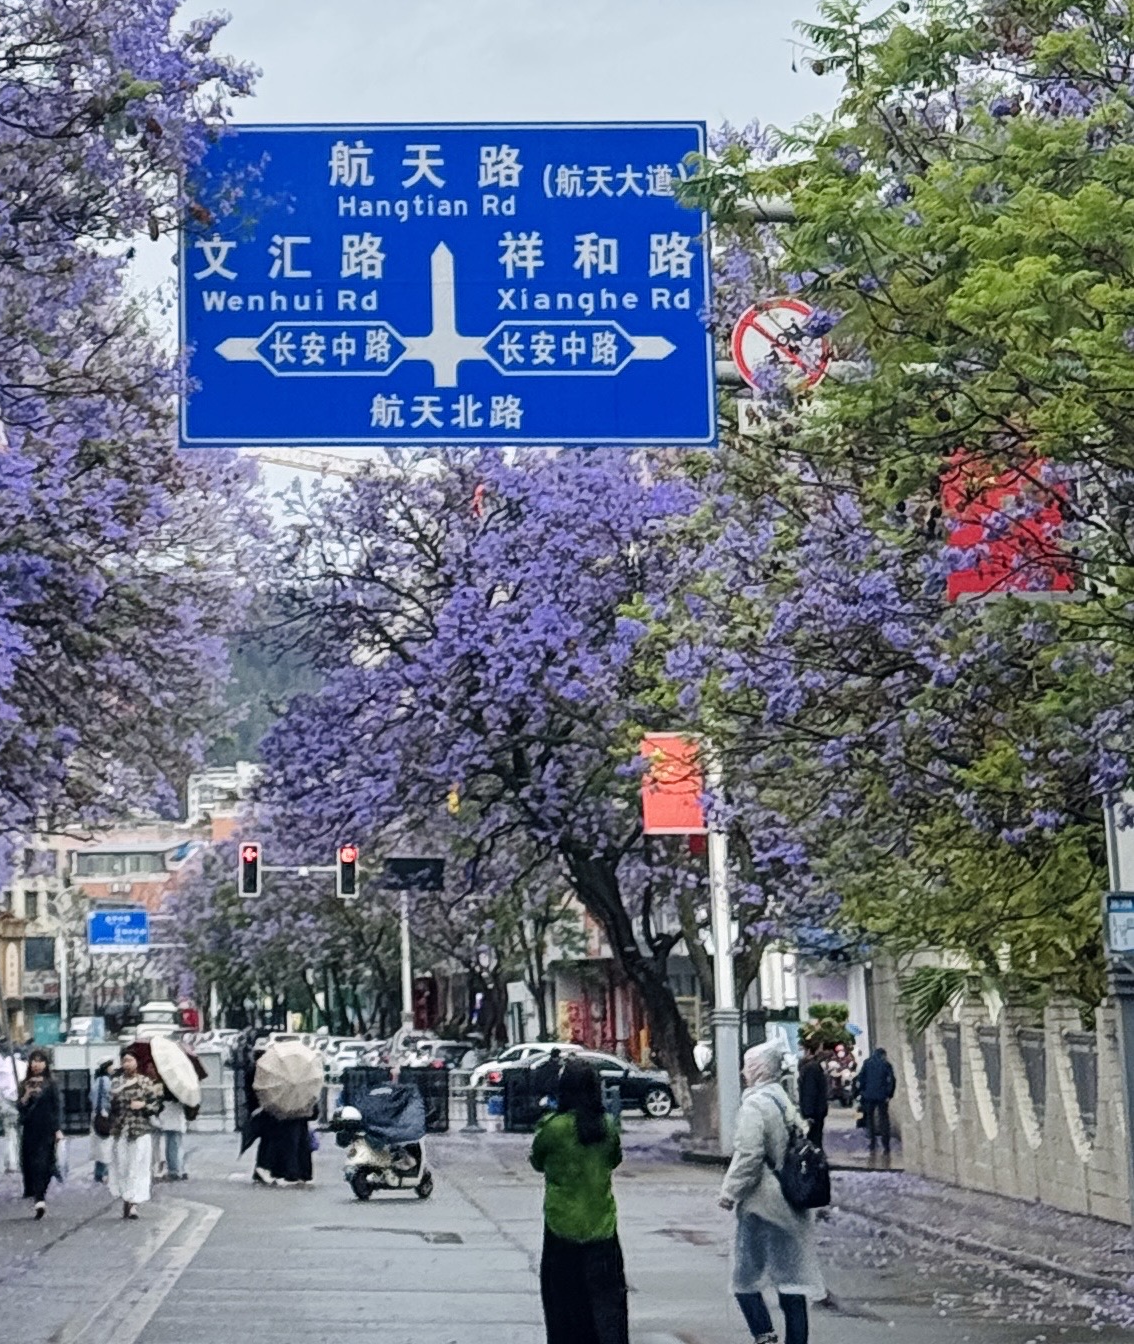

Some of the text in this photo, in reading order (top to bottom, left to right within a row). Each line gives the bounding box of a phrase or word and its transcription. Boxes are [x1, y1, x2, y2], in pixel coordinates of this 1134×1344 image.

[329, 140, 523, 188] 航天路
[338, 195, 516, 221] Hangtian Rd
[194, 232, 386, 280] 文汇路
[499, 231, 694, 279] 祥和路
[202, 290, 378, 312] Wenhui Rd
[498, 288, 691, 315] Xianghe Rd
[270, 330, 391, 365] 长安中路
[498, 330, 618, 365] 长安中路
[371, 394, 524, 429] 航天北路
